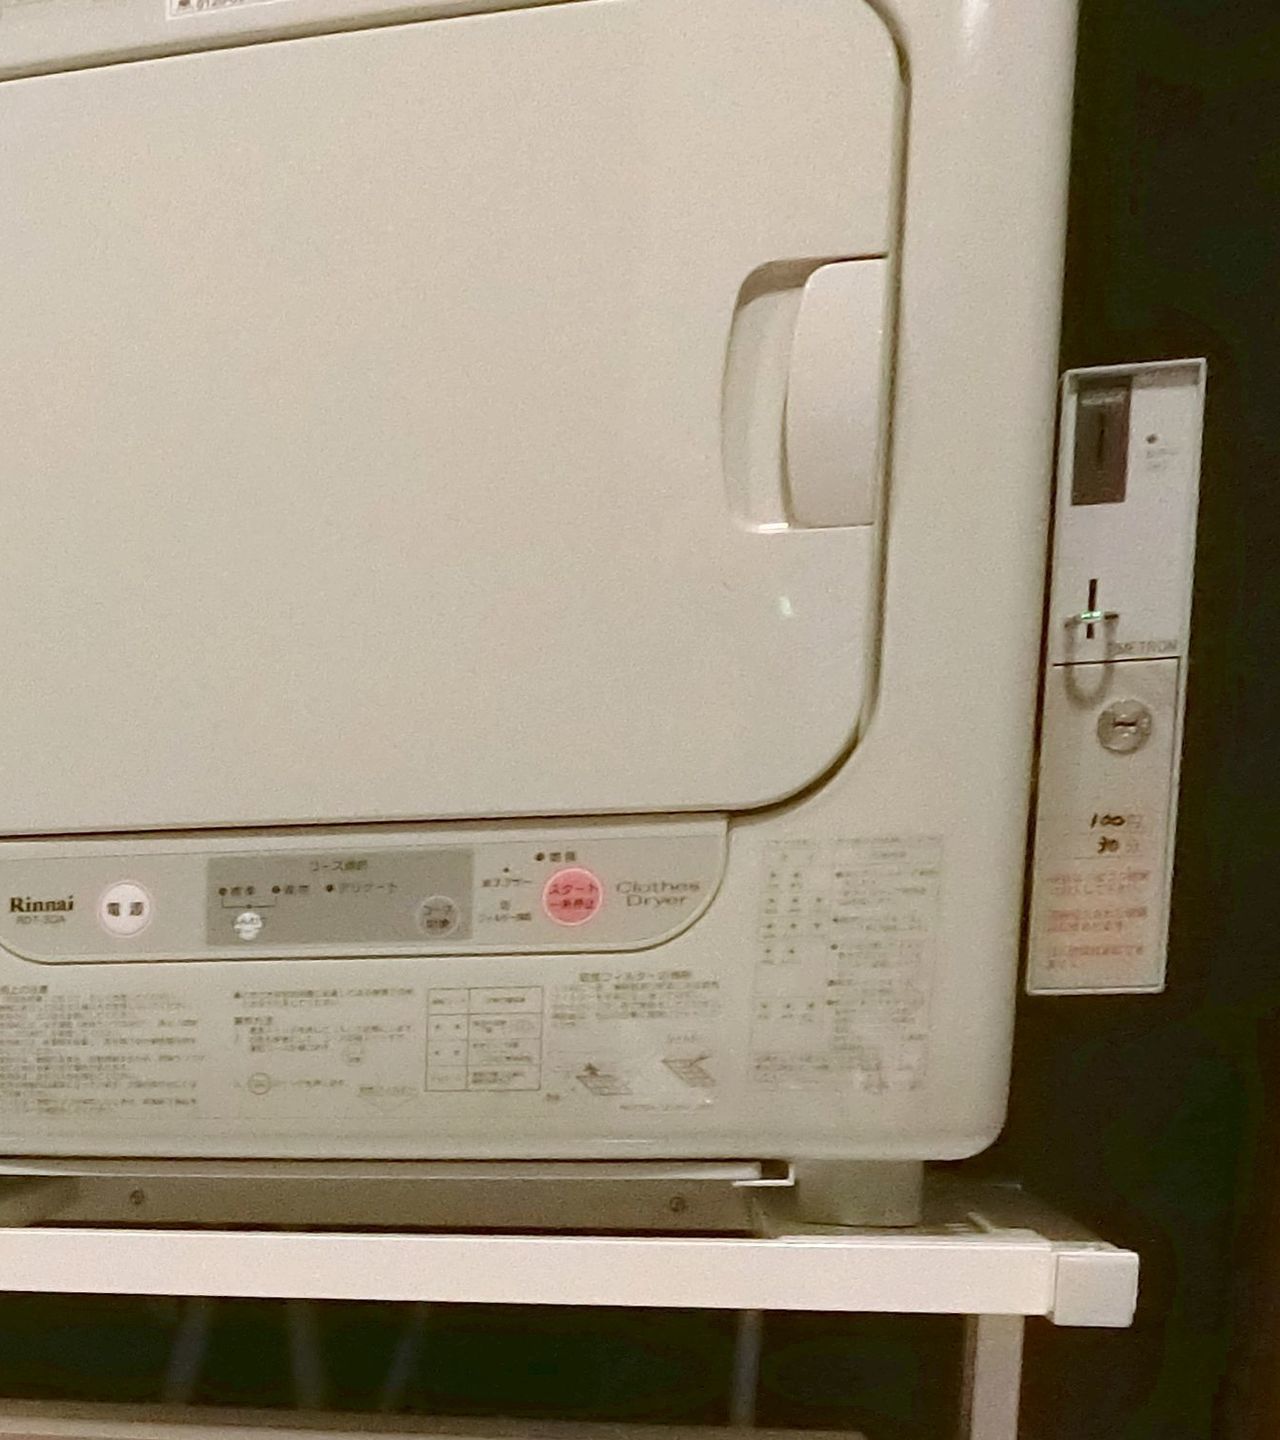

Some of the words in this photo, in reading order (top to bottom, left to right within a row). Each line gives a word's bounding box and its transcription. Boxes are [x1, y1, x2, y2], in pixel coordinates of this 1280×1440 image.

[1091, 813, 1125, 828] 100
[549, 884, 598, 895] スタート
[615, 881, 701, 894] Clothes
[9, 894, 74, 913] Rinnai
[107, 901, 143, 917] 電源
[626, 895, 689, 909] Dryer
